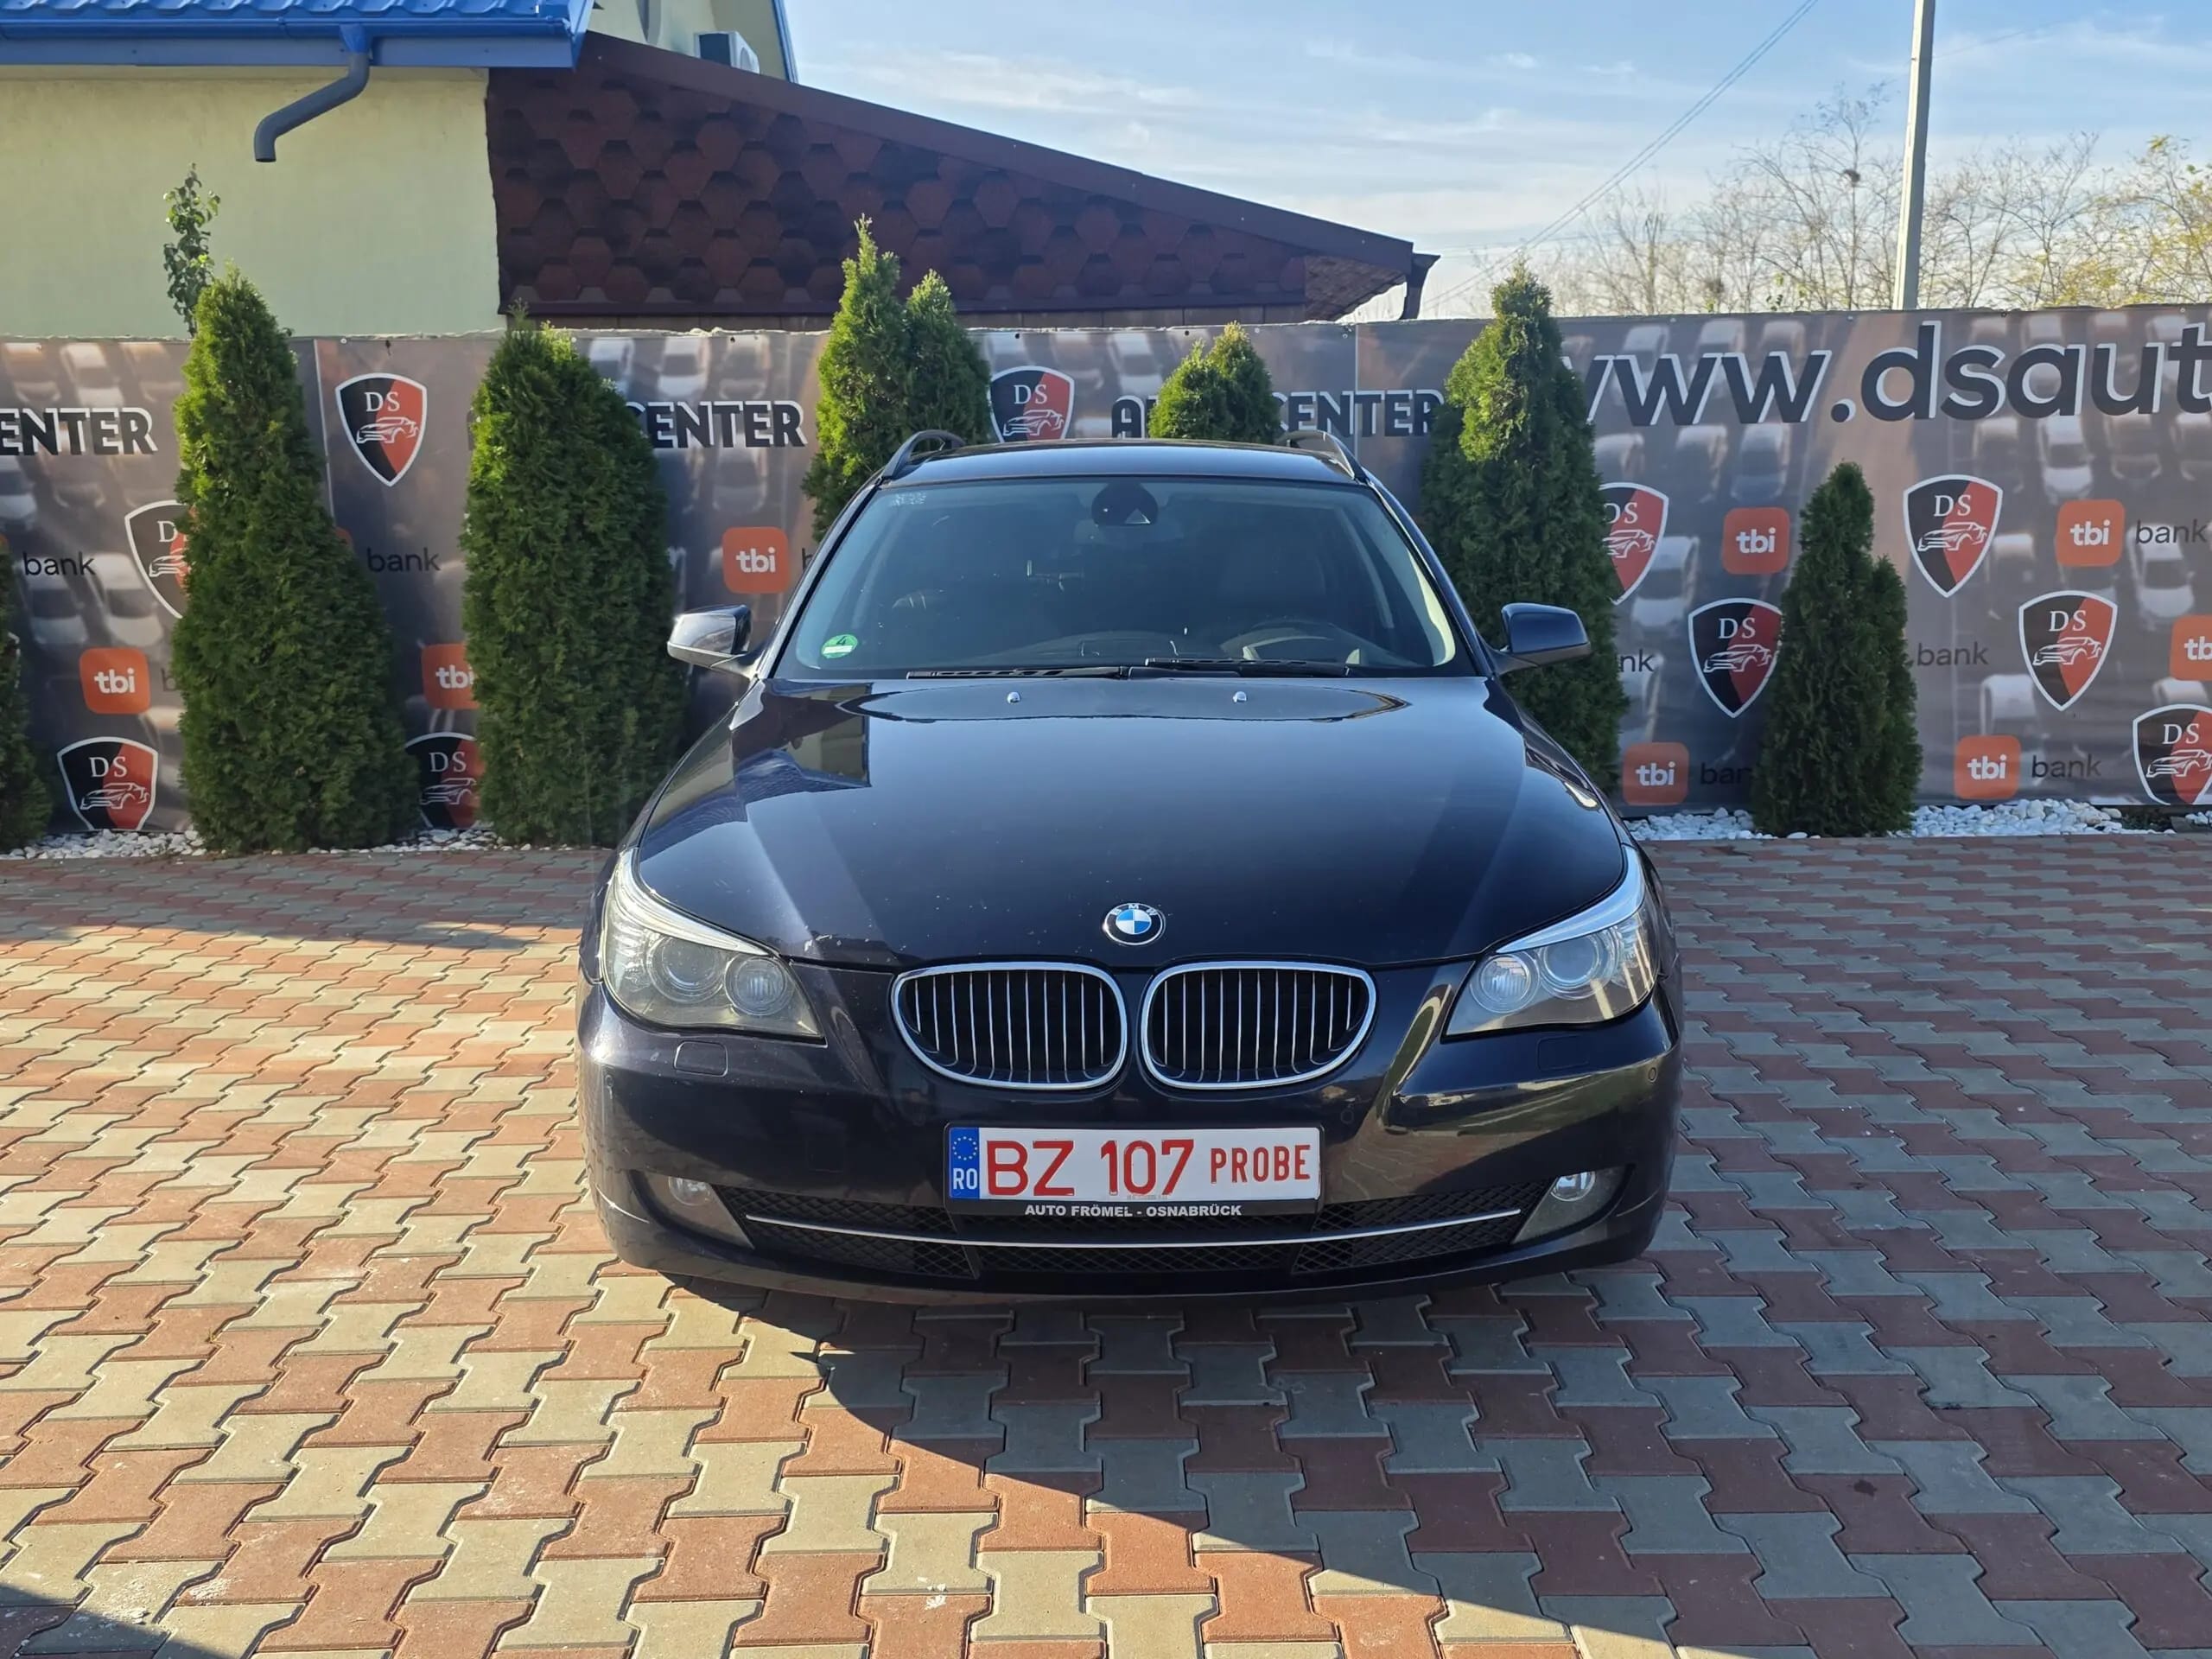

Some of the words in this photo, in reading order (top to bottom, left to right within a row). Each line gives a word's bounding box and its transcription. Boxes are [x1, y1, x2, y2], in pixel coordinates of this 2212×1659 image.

[365, 391, 400, 412] DS
[1014, 385, 1047, 404] DS
[626, 400, 808, 448] ENTER
[1934, 494, 1972, 518] DS
[1736, 527, 1776, 555] tbi
[2069, 519, 2111, 547] tbi
[2136, 519, 2209, 545] bank
[23, 551, 95, 576] bank
[367, 547, 441, 572] bank
[736, 547, 776, 574] tbi
[1719, 618, 1757, 639] DS
[2049, 610, 2087, 632] DS
[1916, 642, 1988, 667] bank
[94, 668, 135, 695] tbi
[2163, 722, 2200, 745] DS
[89, 756, 128, 777] DS
[429, 751, 467, 772] DS
[1967, 755, 2007, 780] tbi
[2031, 753, 2101, 779] bank
[1636, 761, 1675, 787] tbi
[1110, 903, 1159, 916] BMW
[953, 1168, 977, 1190] RO
[987, 1140, 1075, 1196] BZ
[1101, 1139, 1194, 1195] 107
[1211, 1145, 1310, 1184] PROBE
[1025, 1205, 1065, 1217] AUTO
[1071, 1203, 1133, 1217] FRÖMEL
[1146, 1204, 1242, 1217] OSNABRÜCK
